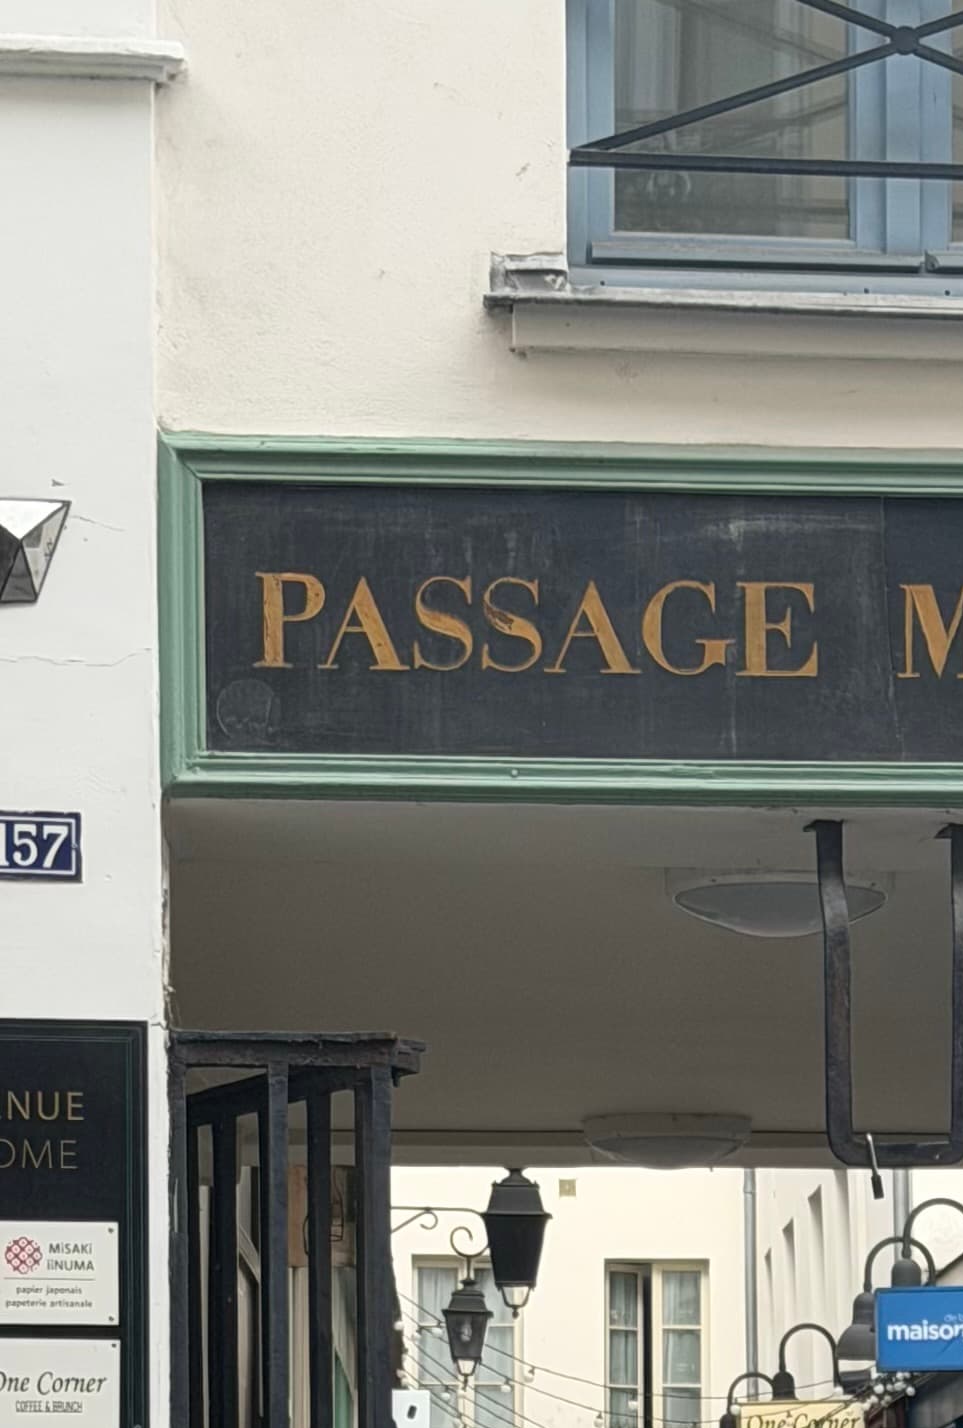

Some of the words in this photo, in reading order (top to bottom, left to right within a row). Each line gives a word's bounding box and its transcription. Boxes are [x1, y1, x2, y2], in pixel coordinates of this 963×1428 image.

[253, 571, 819, 678] PASSAGE
[0, 1090, 85, 1121] NUE
[16, 1285, 43, 1295] papier
[46, 1285, 82, 1296] japonais
[37, 1371, 108, 1395] Corner
